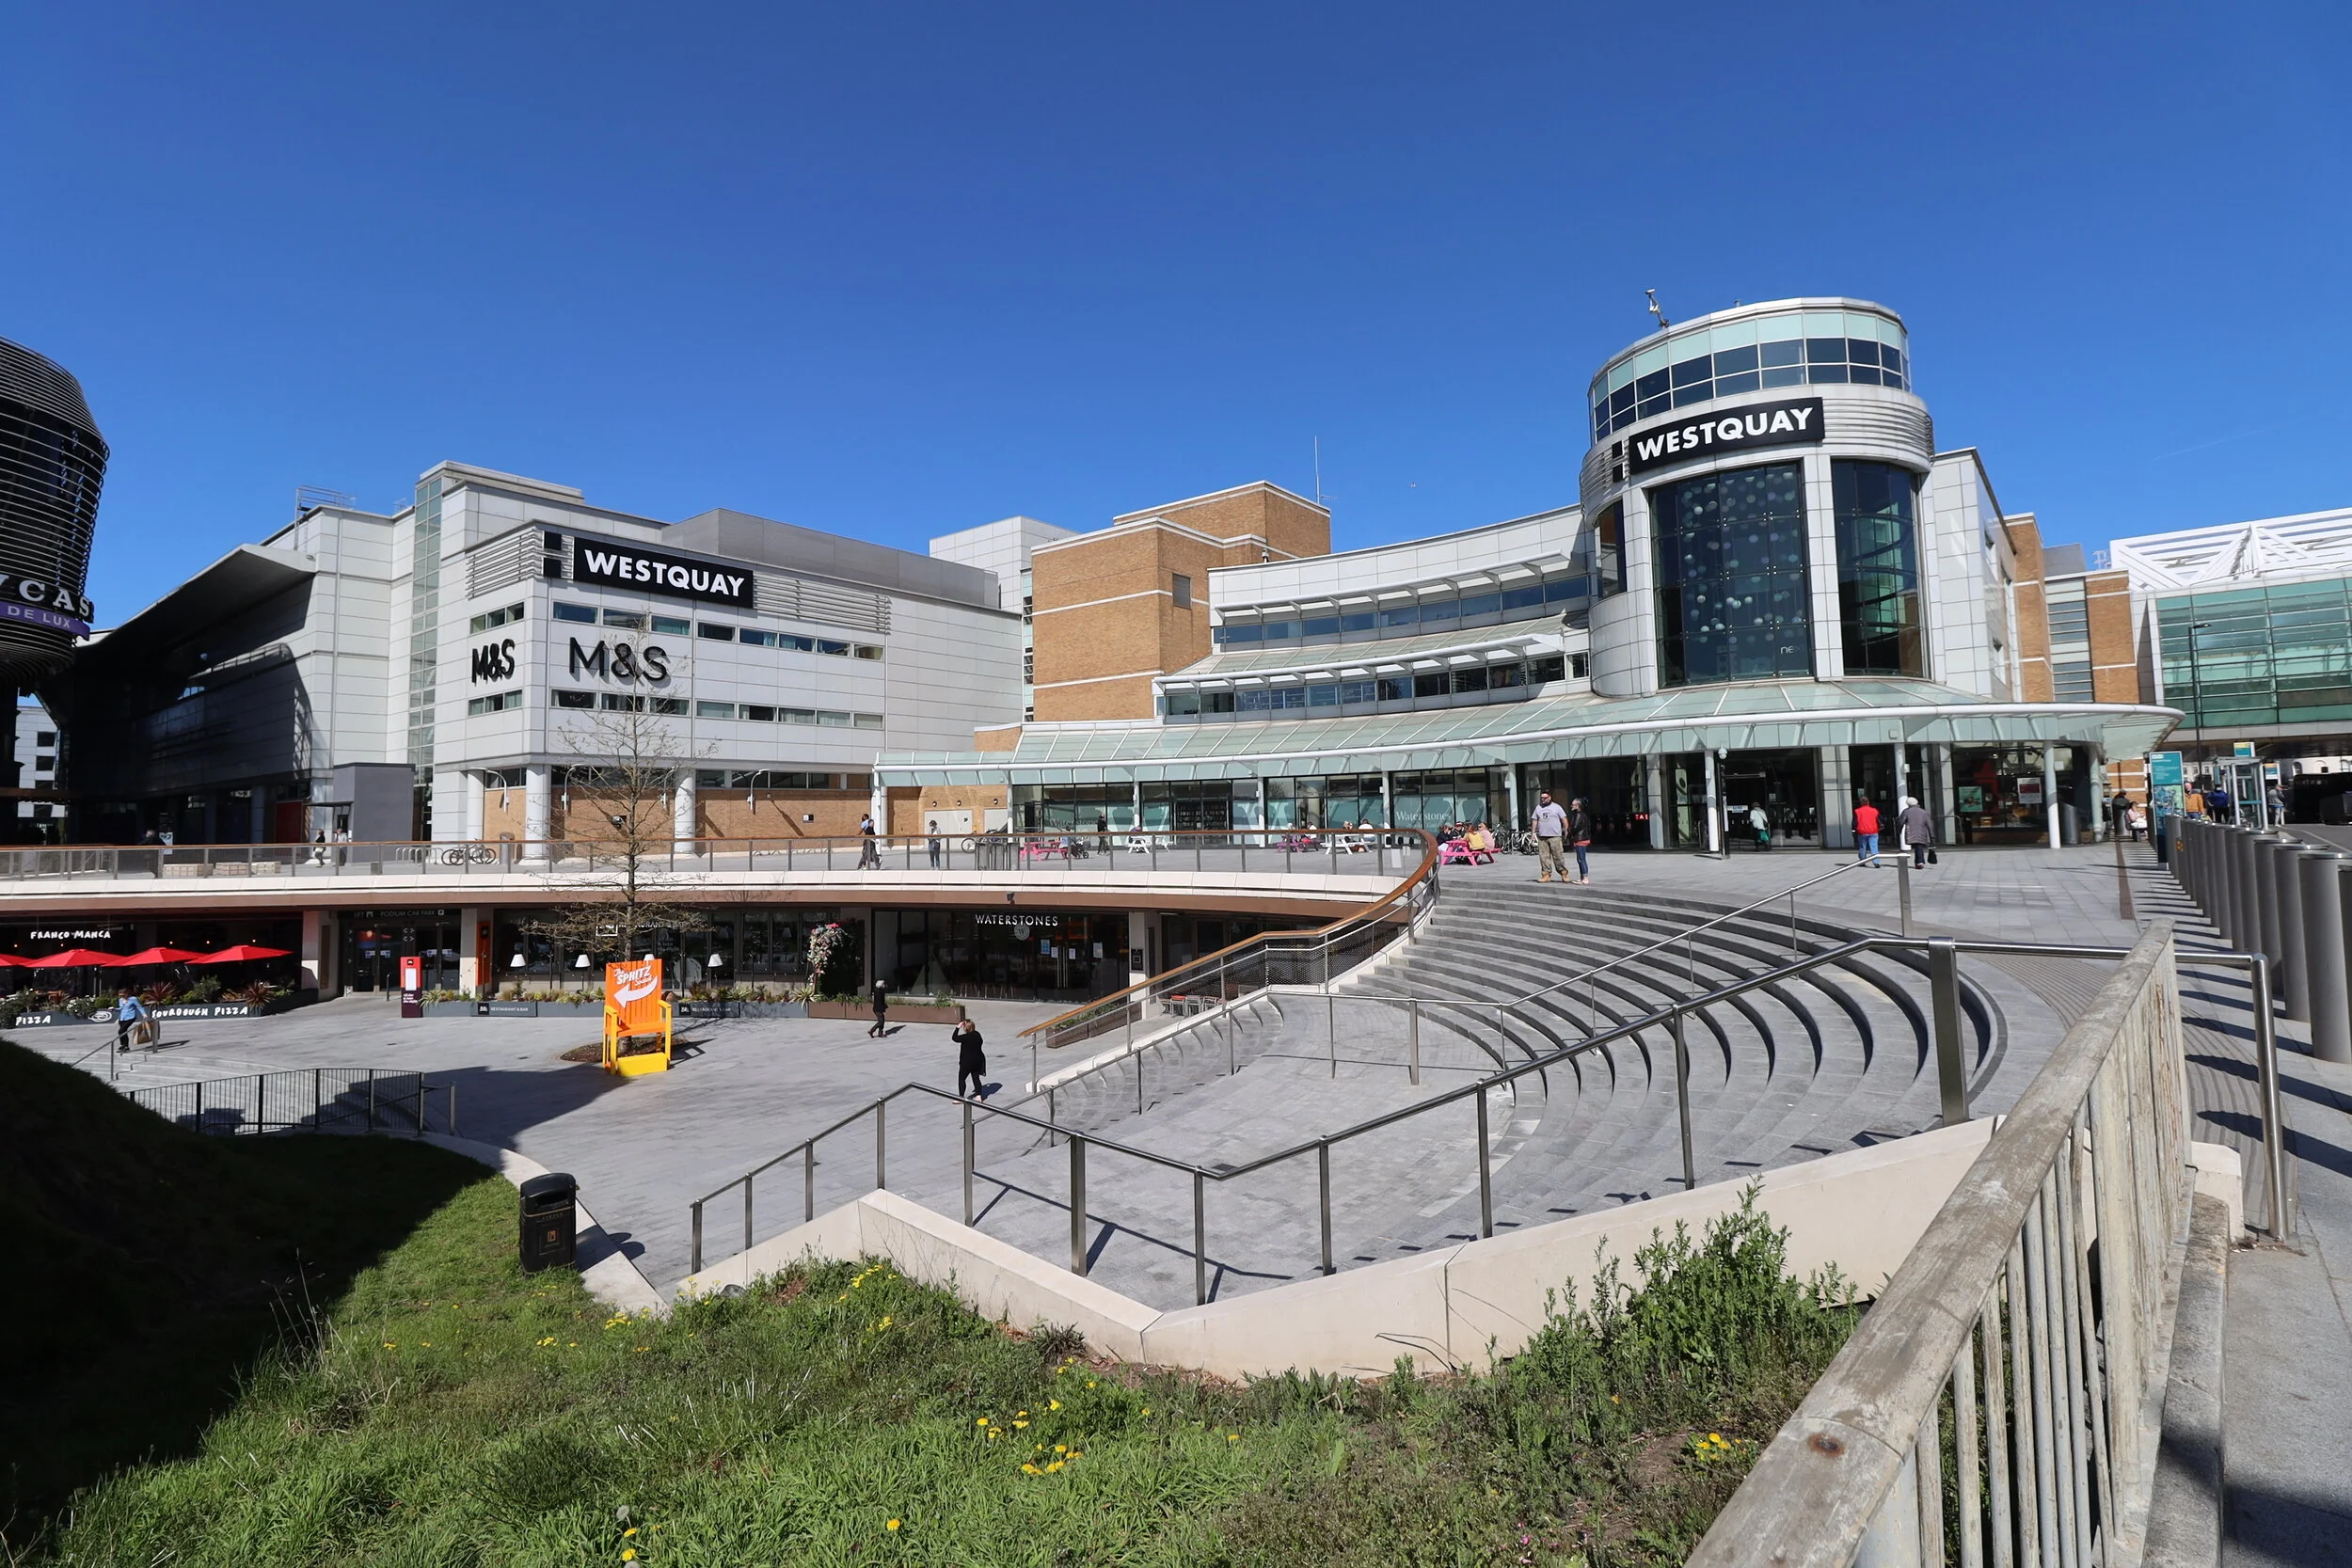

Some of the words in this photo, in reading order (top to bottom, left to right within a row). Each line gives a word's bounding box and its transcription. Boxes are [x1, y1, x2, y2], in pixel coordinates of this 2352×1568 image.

[1637, 407, 1813, 461] WESTQUAY
[584, 549, 744, 596] WESTQUAY
[8, 605, 35, 620] DE
[471, 639, 516, 684] M&S
[569, 637, 667, 681] M&S
[975, 914, 1058, 927] WATERSTONES
[30, 930, 71, 940] FRANCO
[73, 930, 111, 939] MANCA
[15, 1015, 51, 1026] PIZZA
[151, 1007, 208, 1020] SOURDOUGH
[215, 1006, 248, 1016] PIZZA
